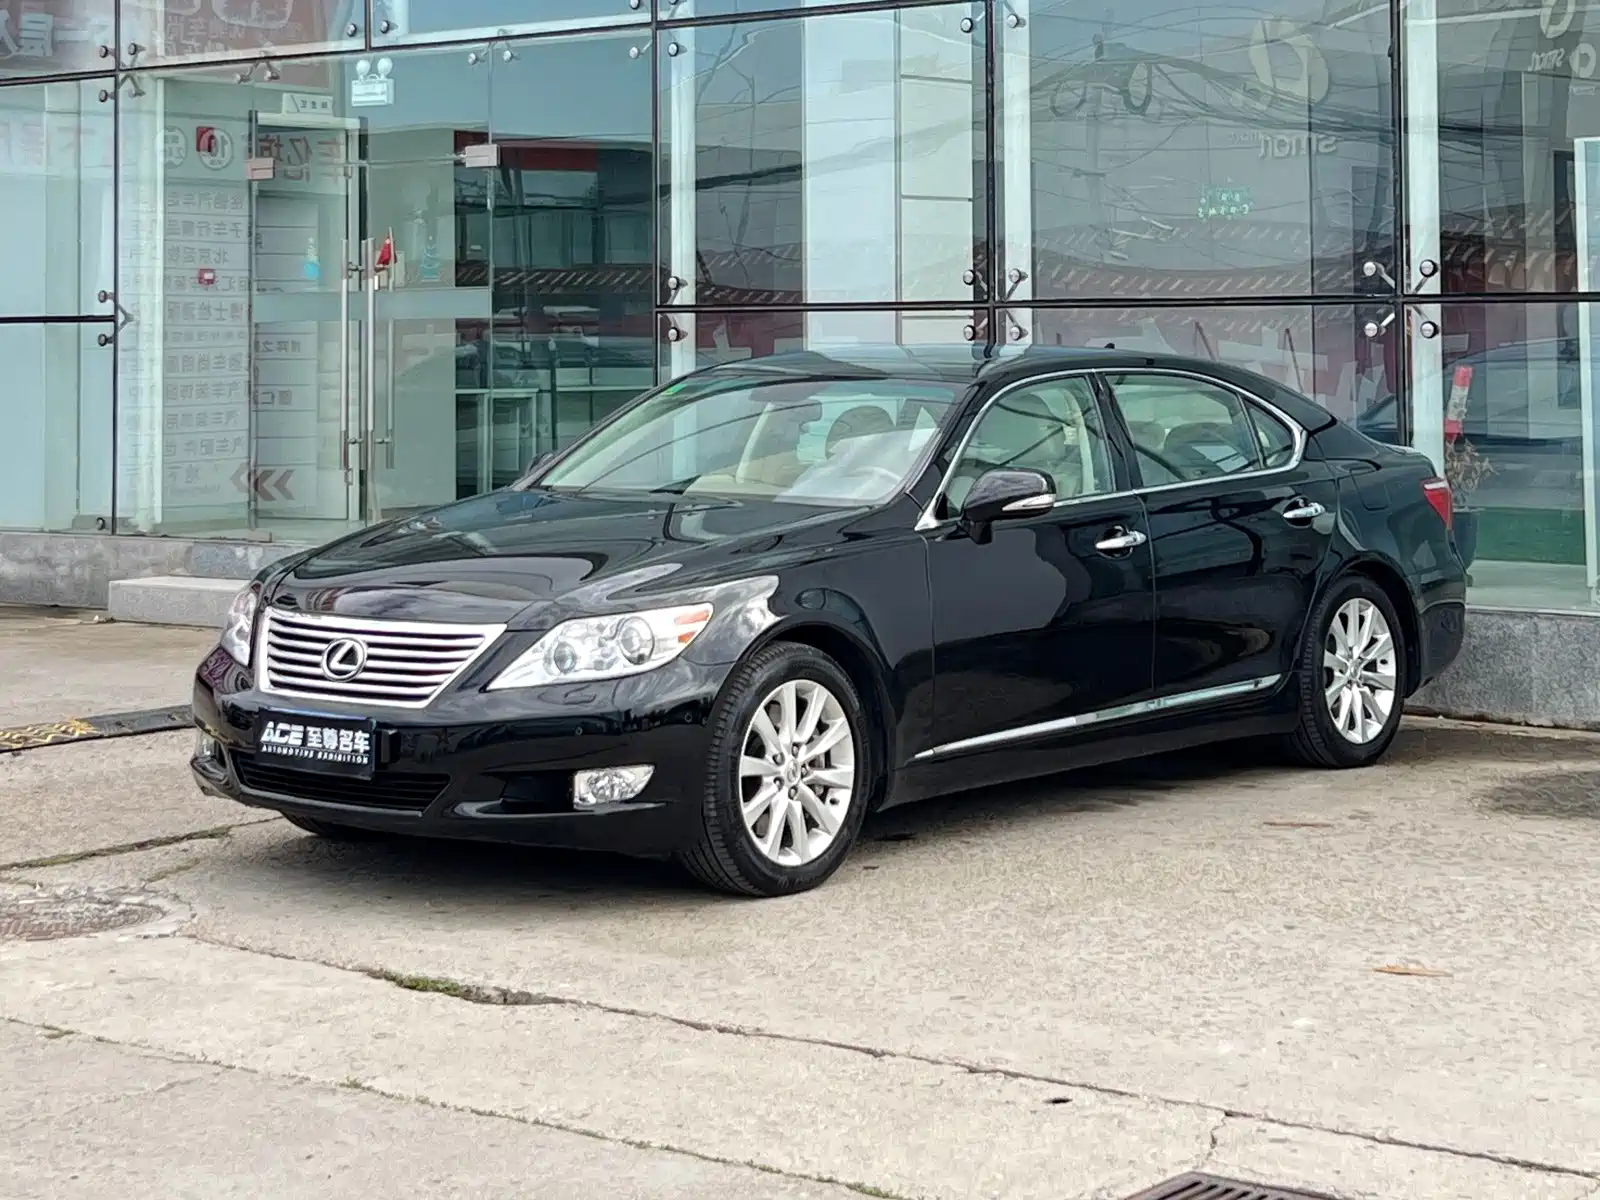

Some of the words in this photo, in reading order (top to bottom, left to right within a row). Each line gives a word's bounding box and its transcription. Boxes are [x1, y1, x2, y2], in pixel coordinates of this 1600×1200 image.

[260, 721, 305, 746] ACE
[306, 725, 371, 754] 至尊名车
[261, 744, 315, 759] AUTOMOTIVE
